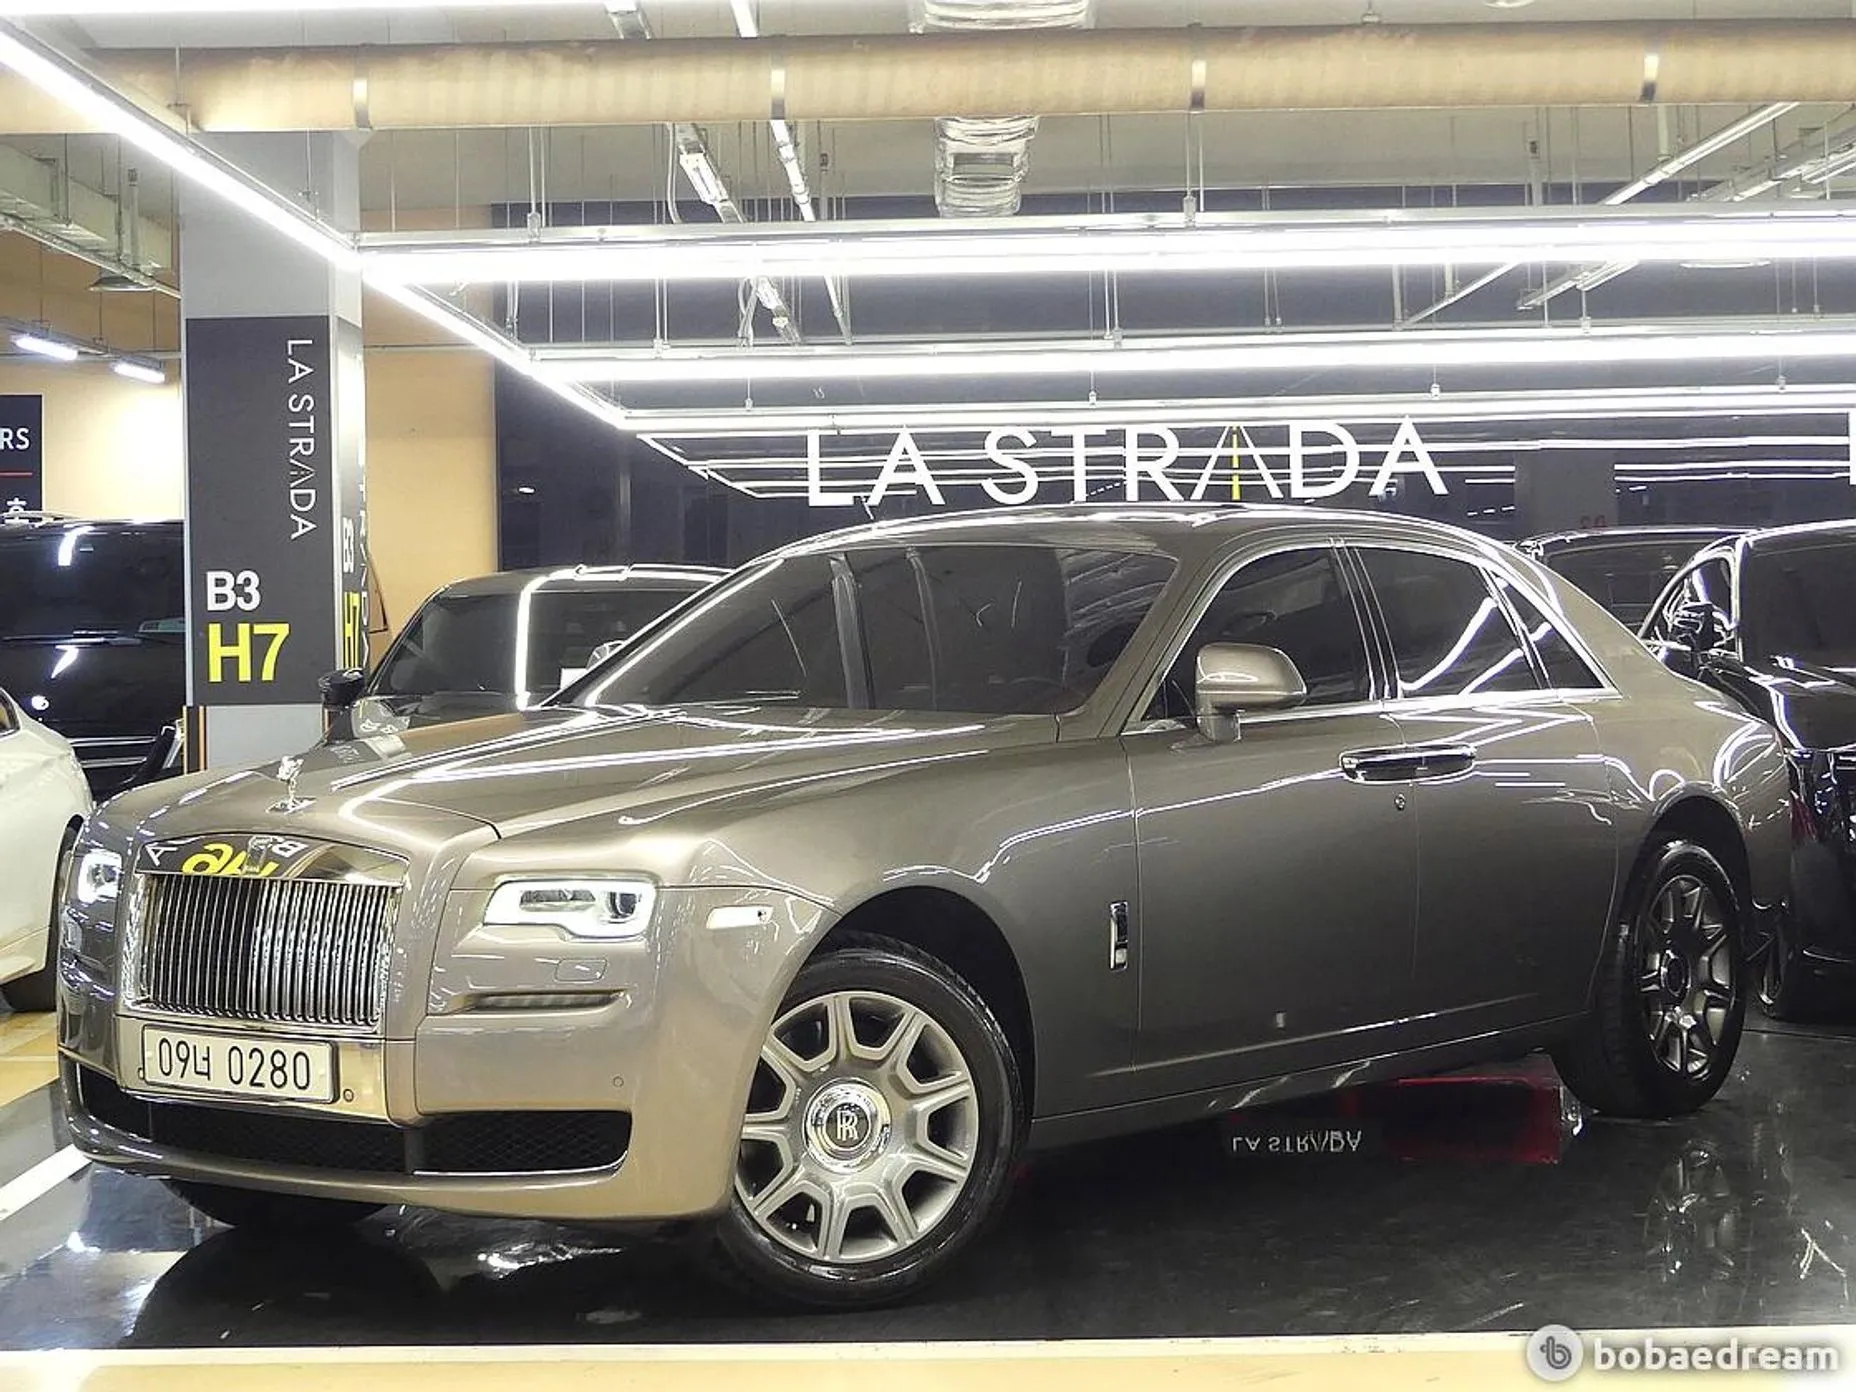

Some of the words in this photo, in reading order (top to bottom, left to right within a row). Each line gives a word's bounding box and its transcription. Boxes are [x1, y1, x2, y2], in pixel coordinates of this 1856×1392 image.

[287, 339, 314, 383] LA
[288, 393, 317, 540] STRADA
[807, 425, 944, 507] LA
[981, 415, 1449, 506] STRADA
[206, 570, 260, 612] B3
[207, 622, 290, 683] H7
[158, 1037, 211, 1081] 09너
[228, 1045, 311, 1090] 0280
